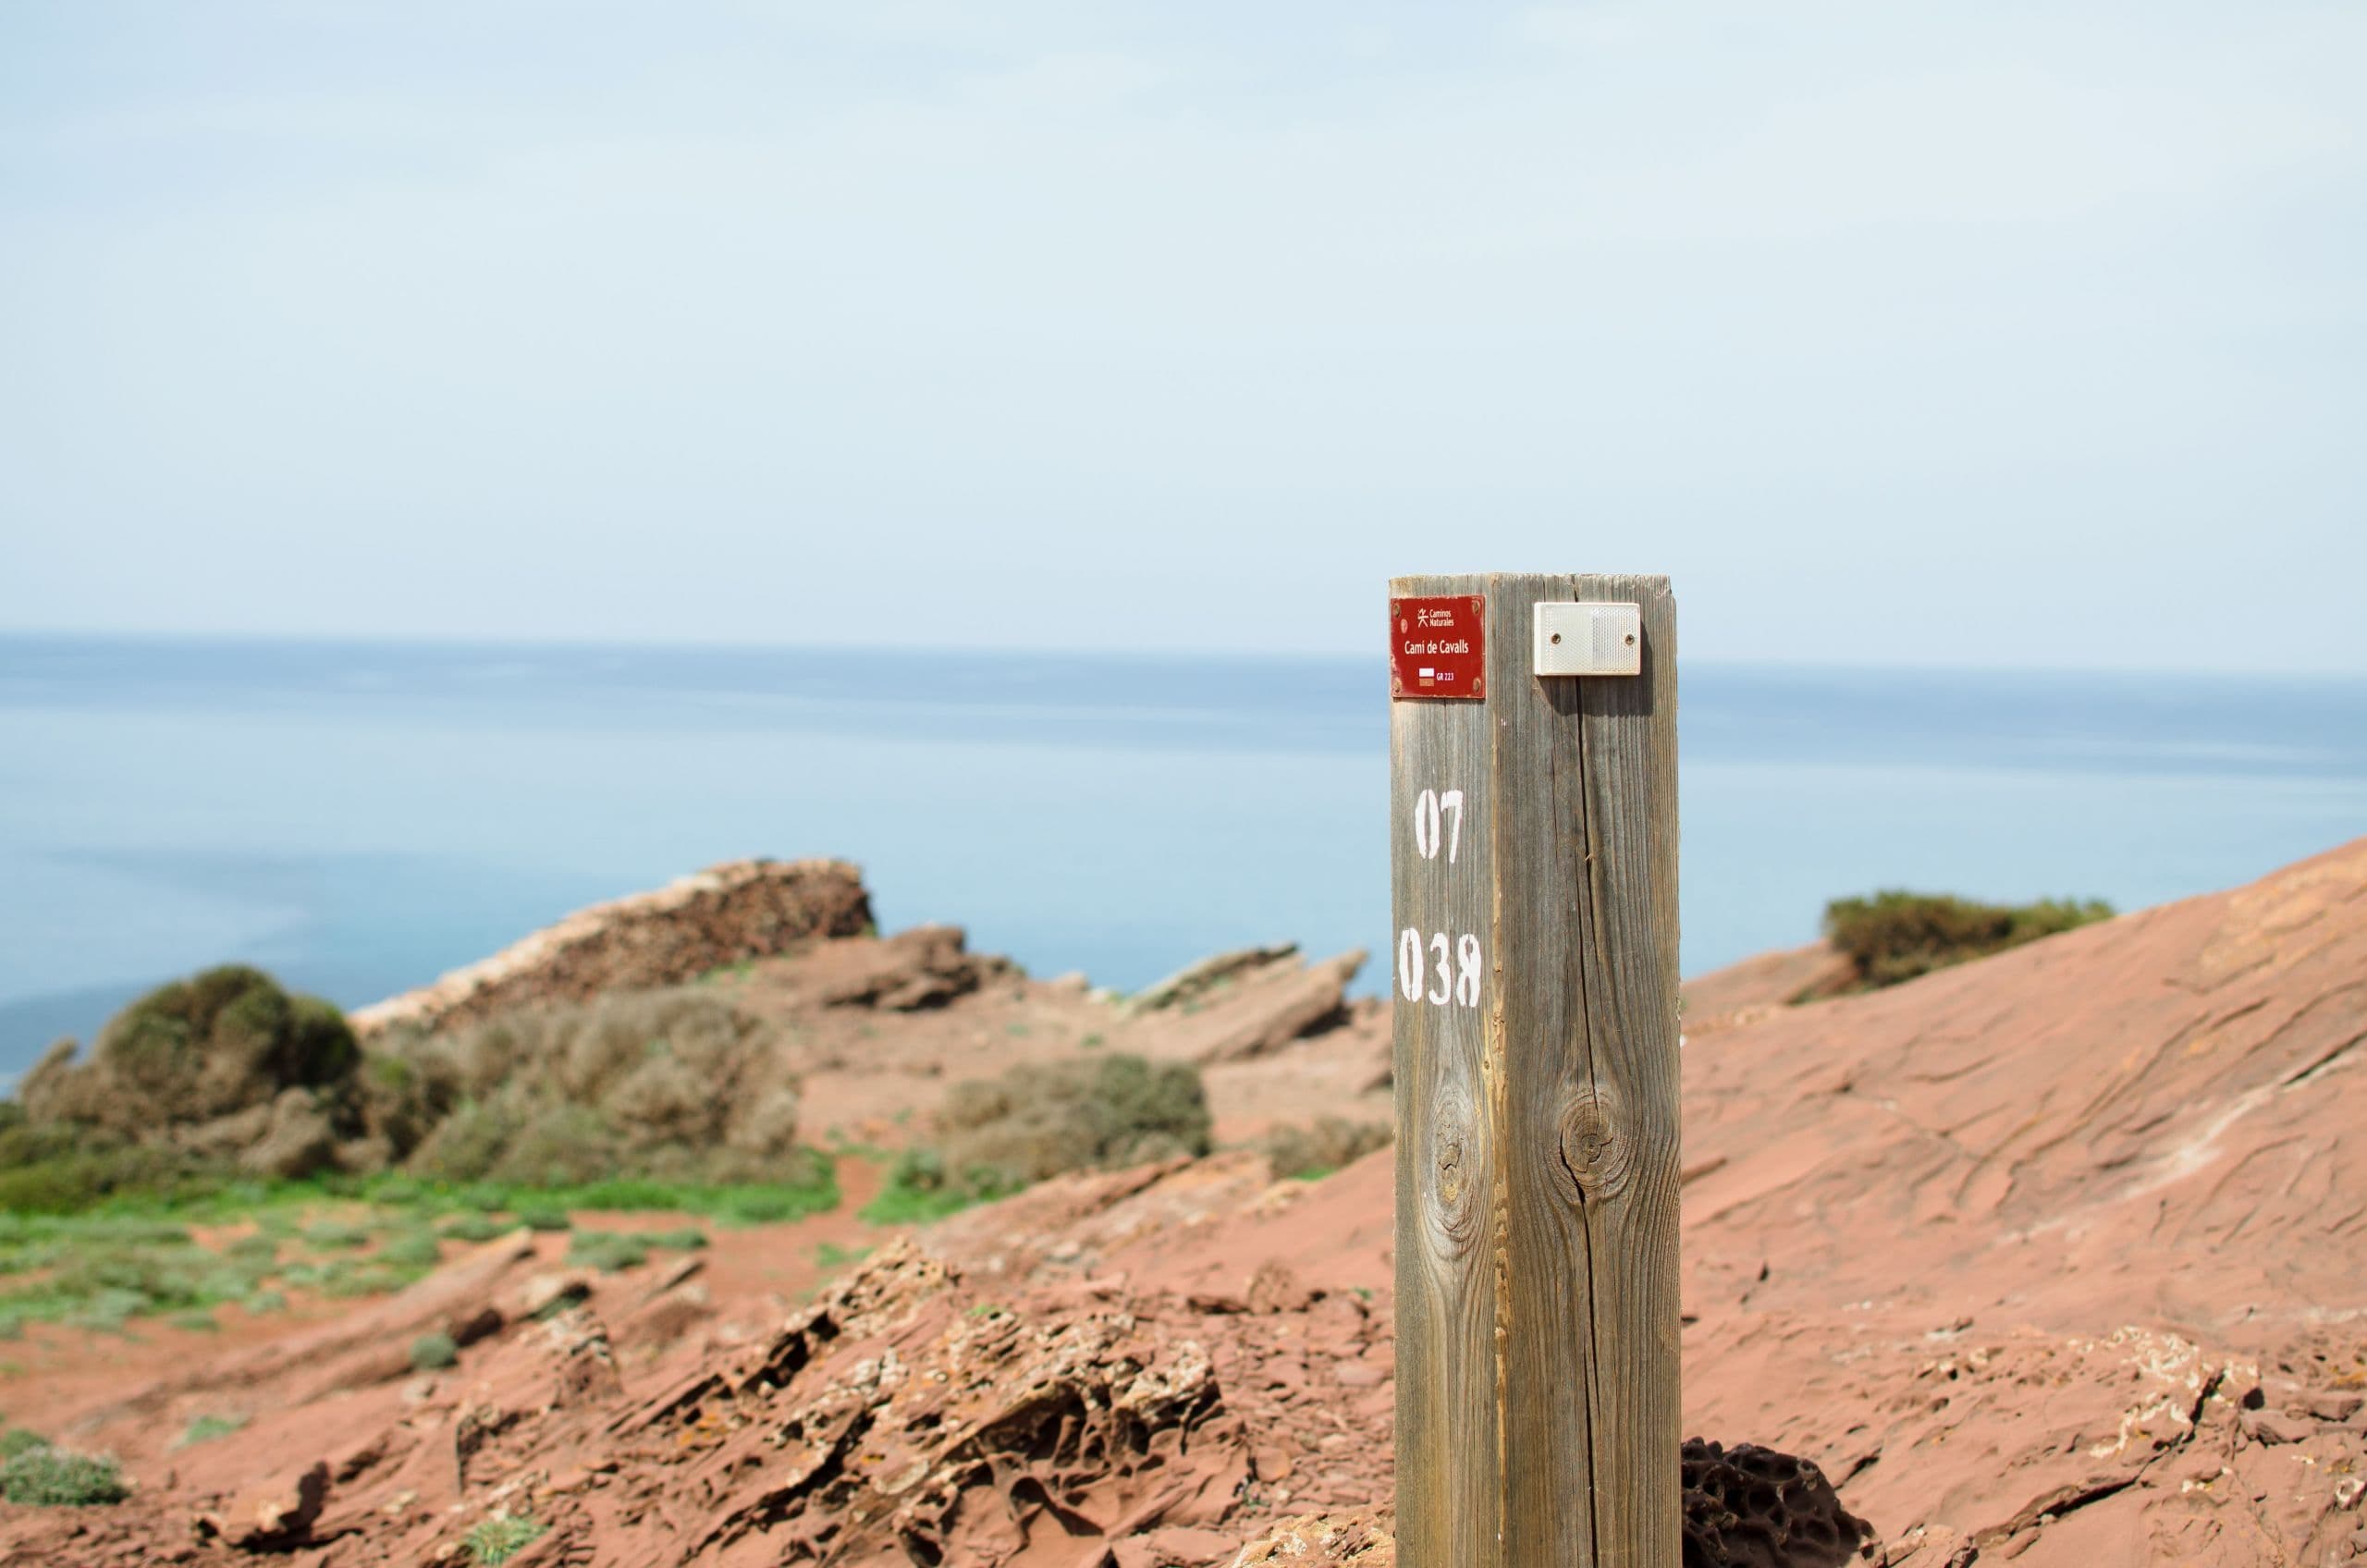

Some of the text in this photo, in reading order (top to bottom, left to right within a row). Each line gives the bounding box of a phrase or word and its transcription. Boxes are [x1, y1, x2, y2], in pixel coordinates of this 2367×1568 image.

[1429, 609, 1452, 618] Caminos
[1429, 619, 1454, 627] Naturales
[1427, 640, 1438, 655] de
[1440, 639, 1469, 654] Cavalls
[1444, 672, 1454, 681] 223
[1415, 789, 1464, 864] 07
[1399, 927, 1481, 1008] 038
